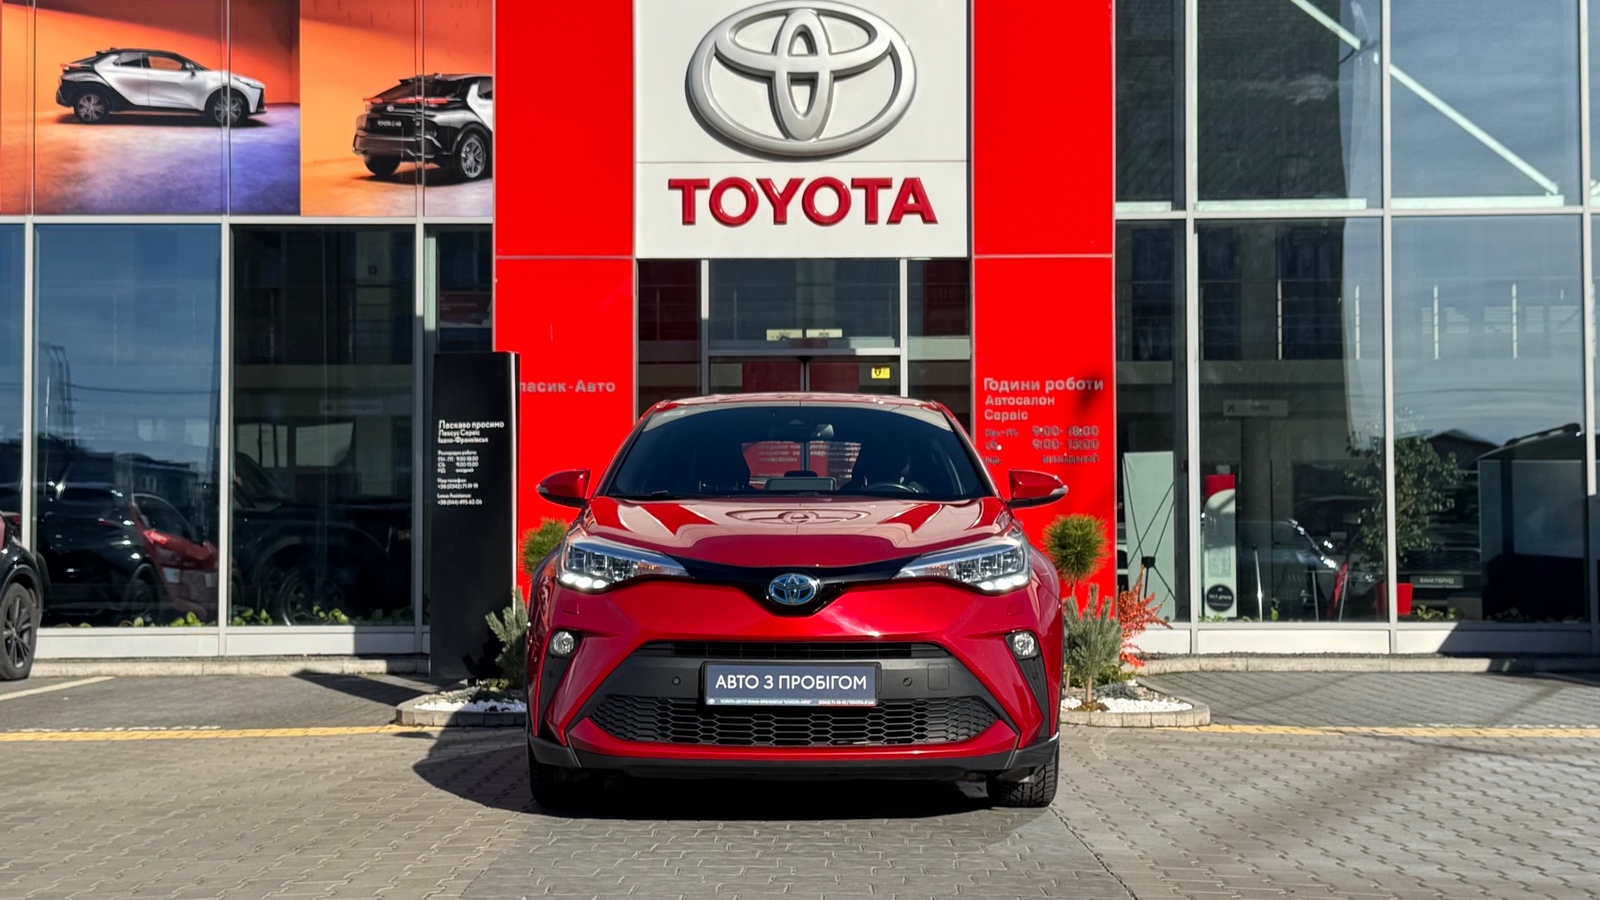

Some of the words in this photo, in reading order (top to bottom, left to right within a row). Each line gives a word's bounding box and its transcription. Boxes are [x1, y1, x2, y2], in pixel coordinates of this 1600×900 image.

[668, 176, 938, 227] TOYOTA
[983, 377, 1040, 393] Години
[1045, 377, 1104, 394] роботи
[985, 394, 1055, 406] Автосалон
[984, 408, 1028, 422] Сервіс
[439, 420, 470, 429] Ласкаво
[472, 422, 504, 430] просимо
[715, 674, 760, 690] АВТО
[763, 675, 774, 690] З
[778, 675, 867, 690] ПРОБІГОМ
